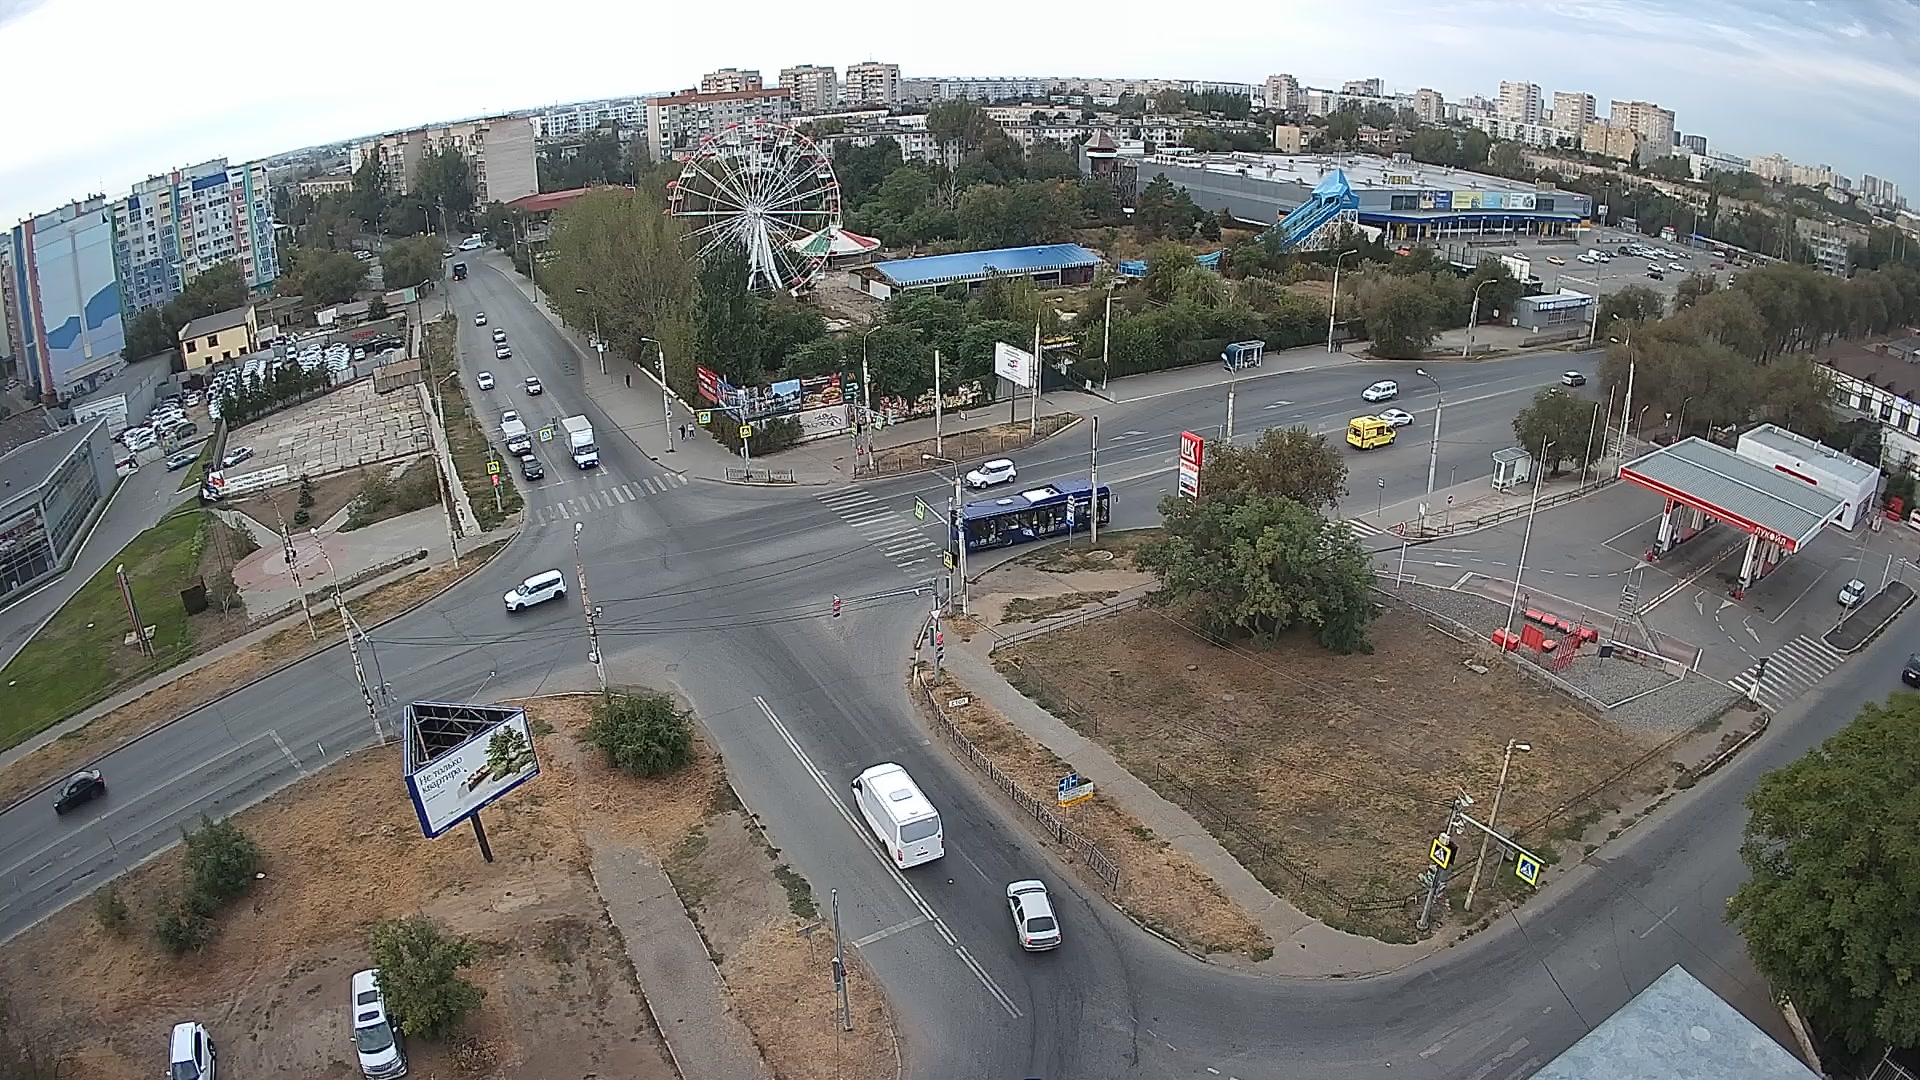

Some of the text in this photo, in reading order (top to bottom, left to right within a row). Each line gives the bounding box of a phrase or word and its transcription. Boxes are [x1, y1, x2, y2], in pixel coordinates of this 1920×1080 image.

[1754, 527, 1787, 545] ЛУКОЙЛ
[418, 756, 463, 786] Не только
[421, 767, 461, 794] квартира
